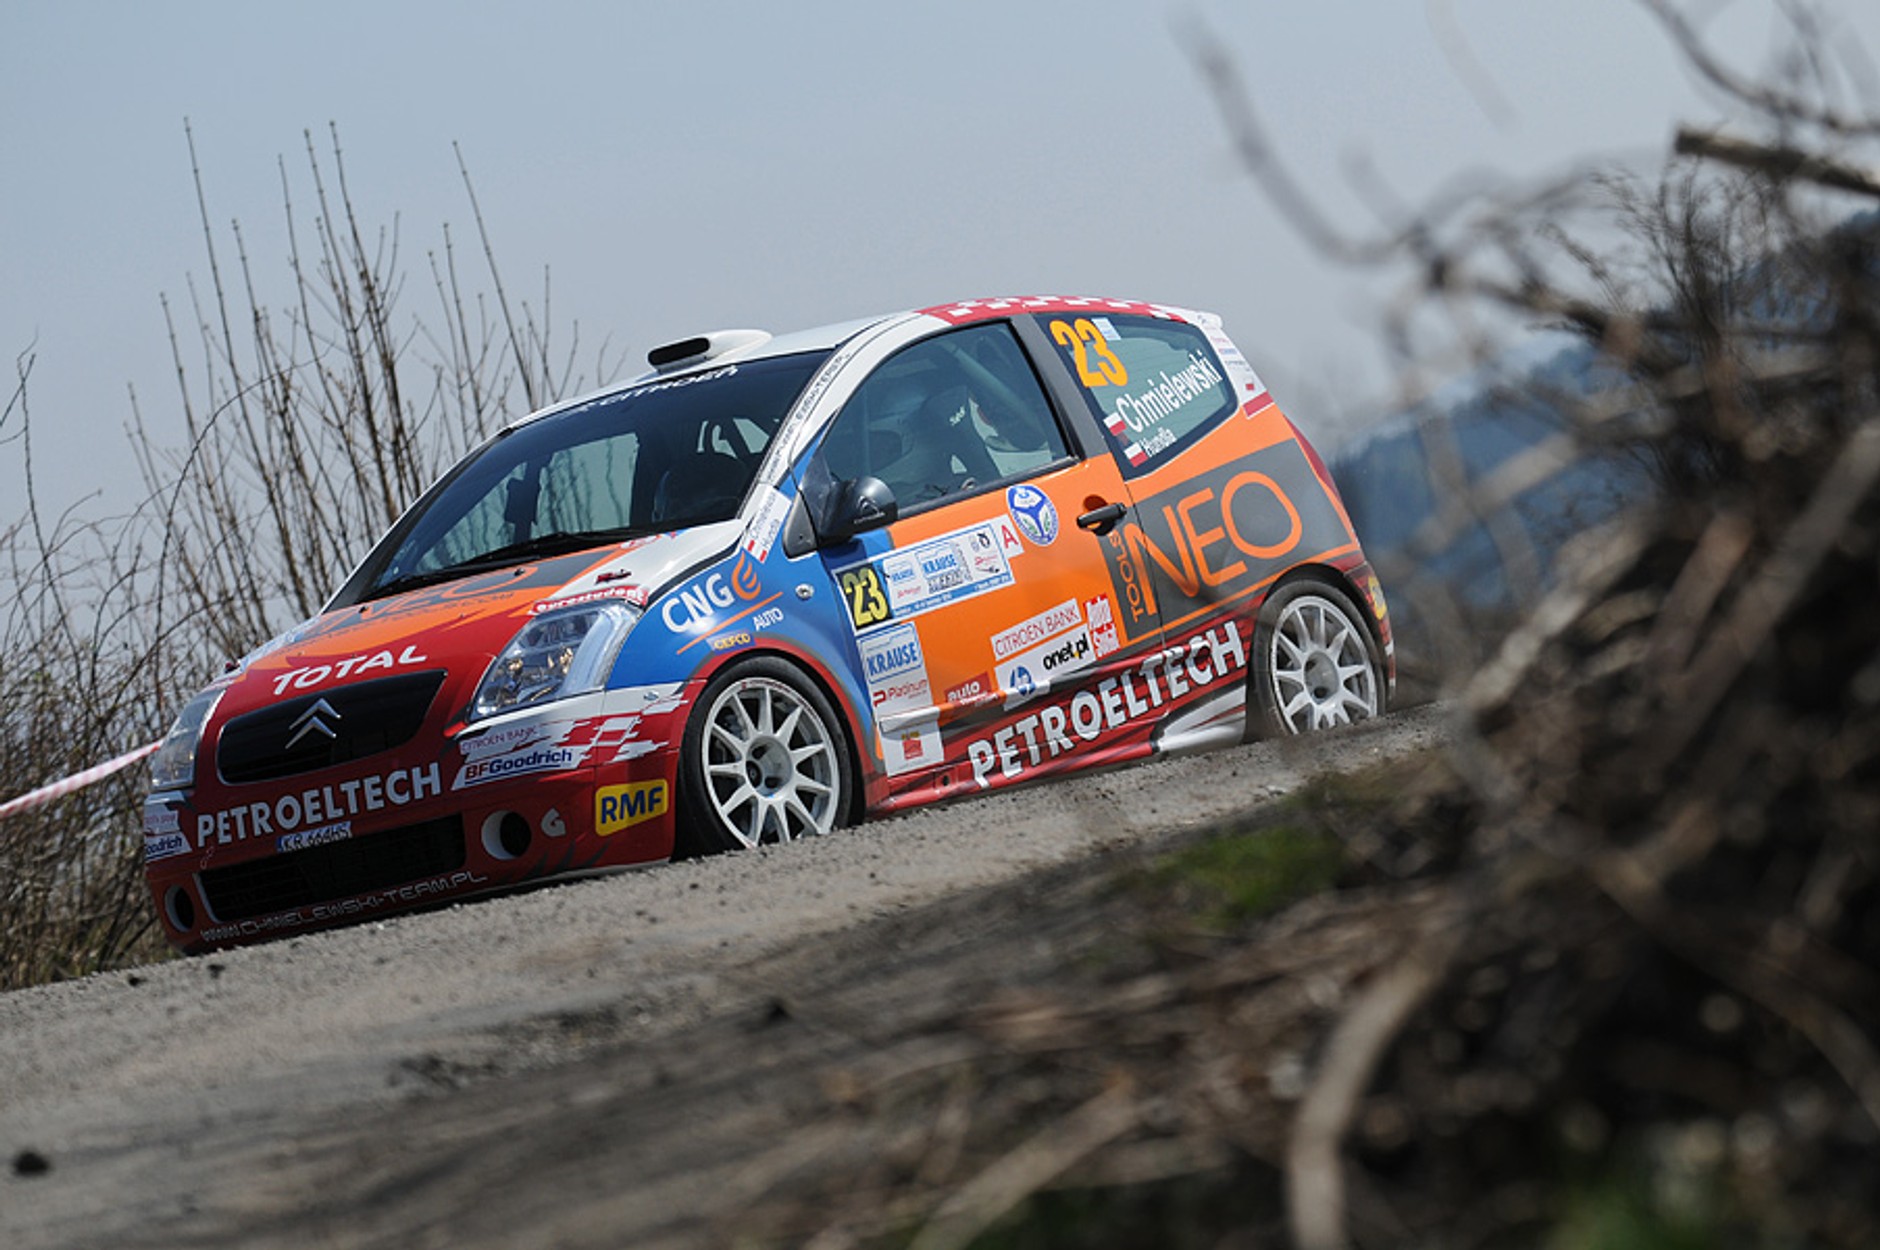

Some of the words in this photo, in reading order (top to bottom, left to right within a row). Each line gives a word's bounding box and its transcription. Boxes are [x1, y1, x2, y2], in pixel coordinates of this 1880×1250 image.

[1049, 317, 1129, 388] 23
[1116, 349, 1223, 433] Chmielewski
[1000, 524, 1019, 549] A
[1123, 471, 1303, 616] NEO
[661, 572, 735, 634] CNG
[842, 567, 889, 627] 23
[1107, 529, 1144, 623] TOOLS
[752, 606, 784, 632] AUTO
[1045, 605, 1081, 633] BANK
[272, 644, 428, 696] TOTAL
[866, 642, 919, 677] KRAUSE
[1042, 633, 1091, 671] onet.pl
[967, 619, 1247, 790] PETROELTECH
[463, 748, 573, 780] BFGoodrich
[196, 761, 442, 848] PETROELTECH
[600, 785, 664, 825] RMF
